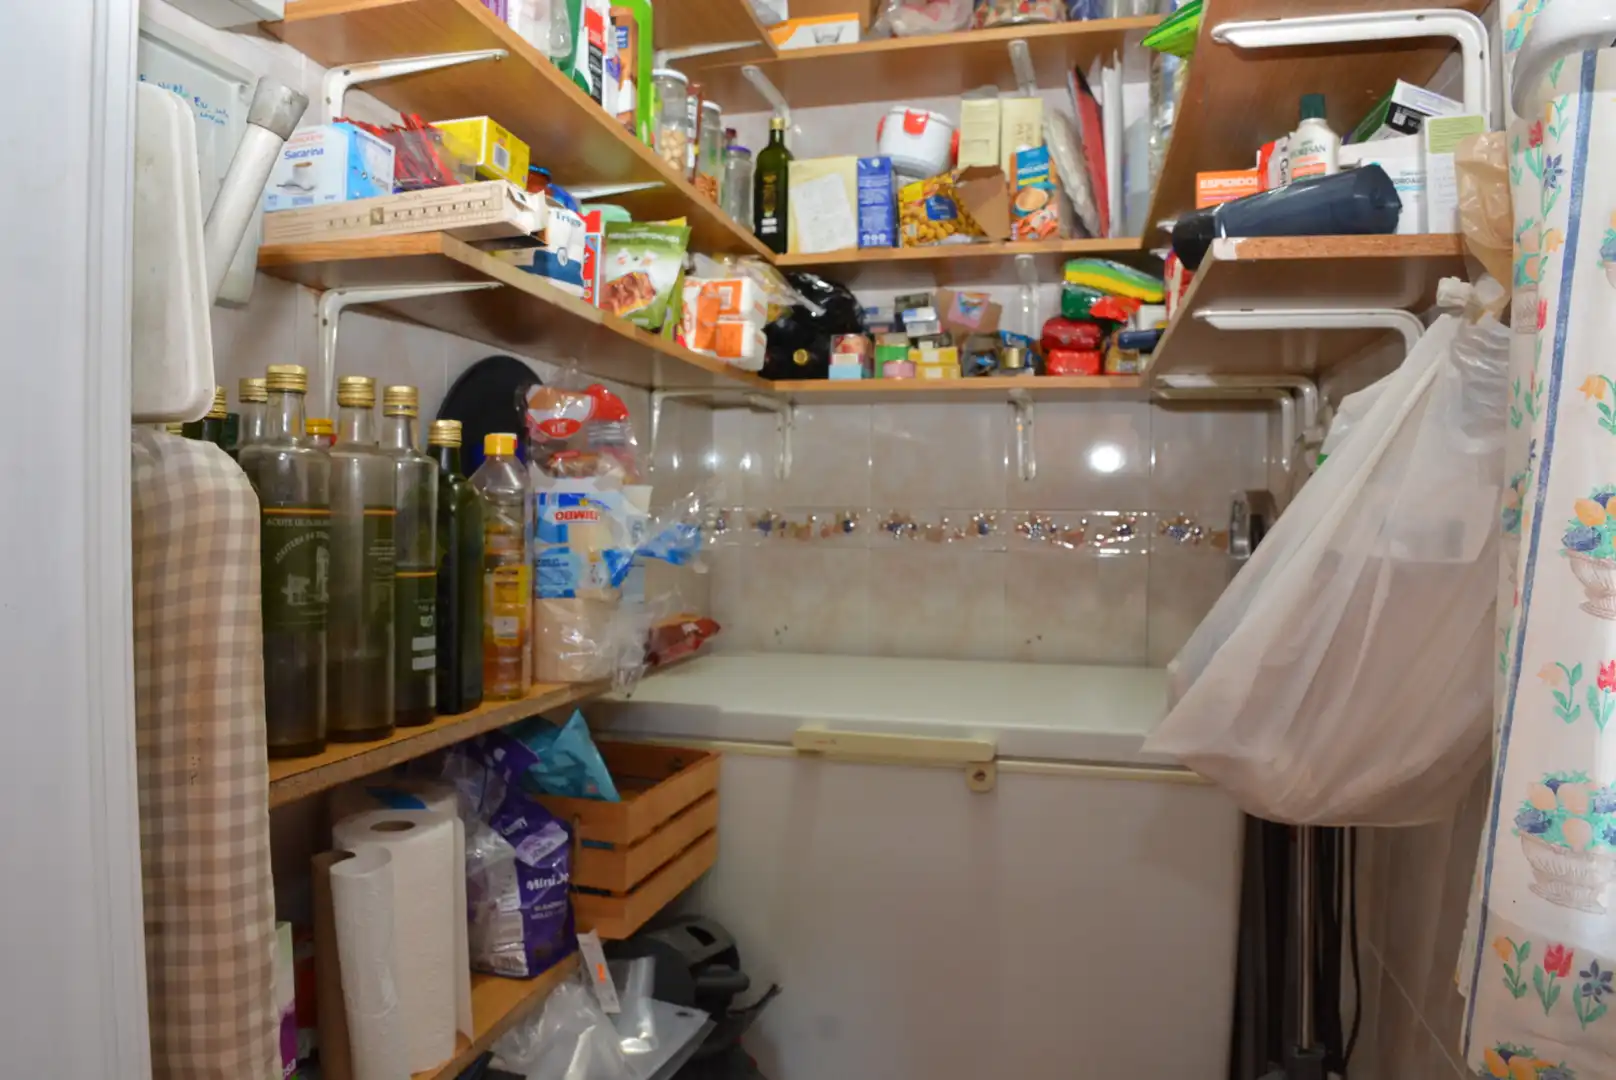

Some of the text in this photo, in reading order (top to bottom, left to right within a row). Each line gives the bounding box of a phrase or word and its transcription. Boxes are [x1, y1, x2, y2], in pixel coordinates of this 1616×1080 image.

[283, 147, 324, 160] Sacarina
[554, 510, 598, 521] BIMBO
[526, 874, 556, 891] Mini
